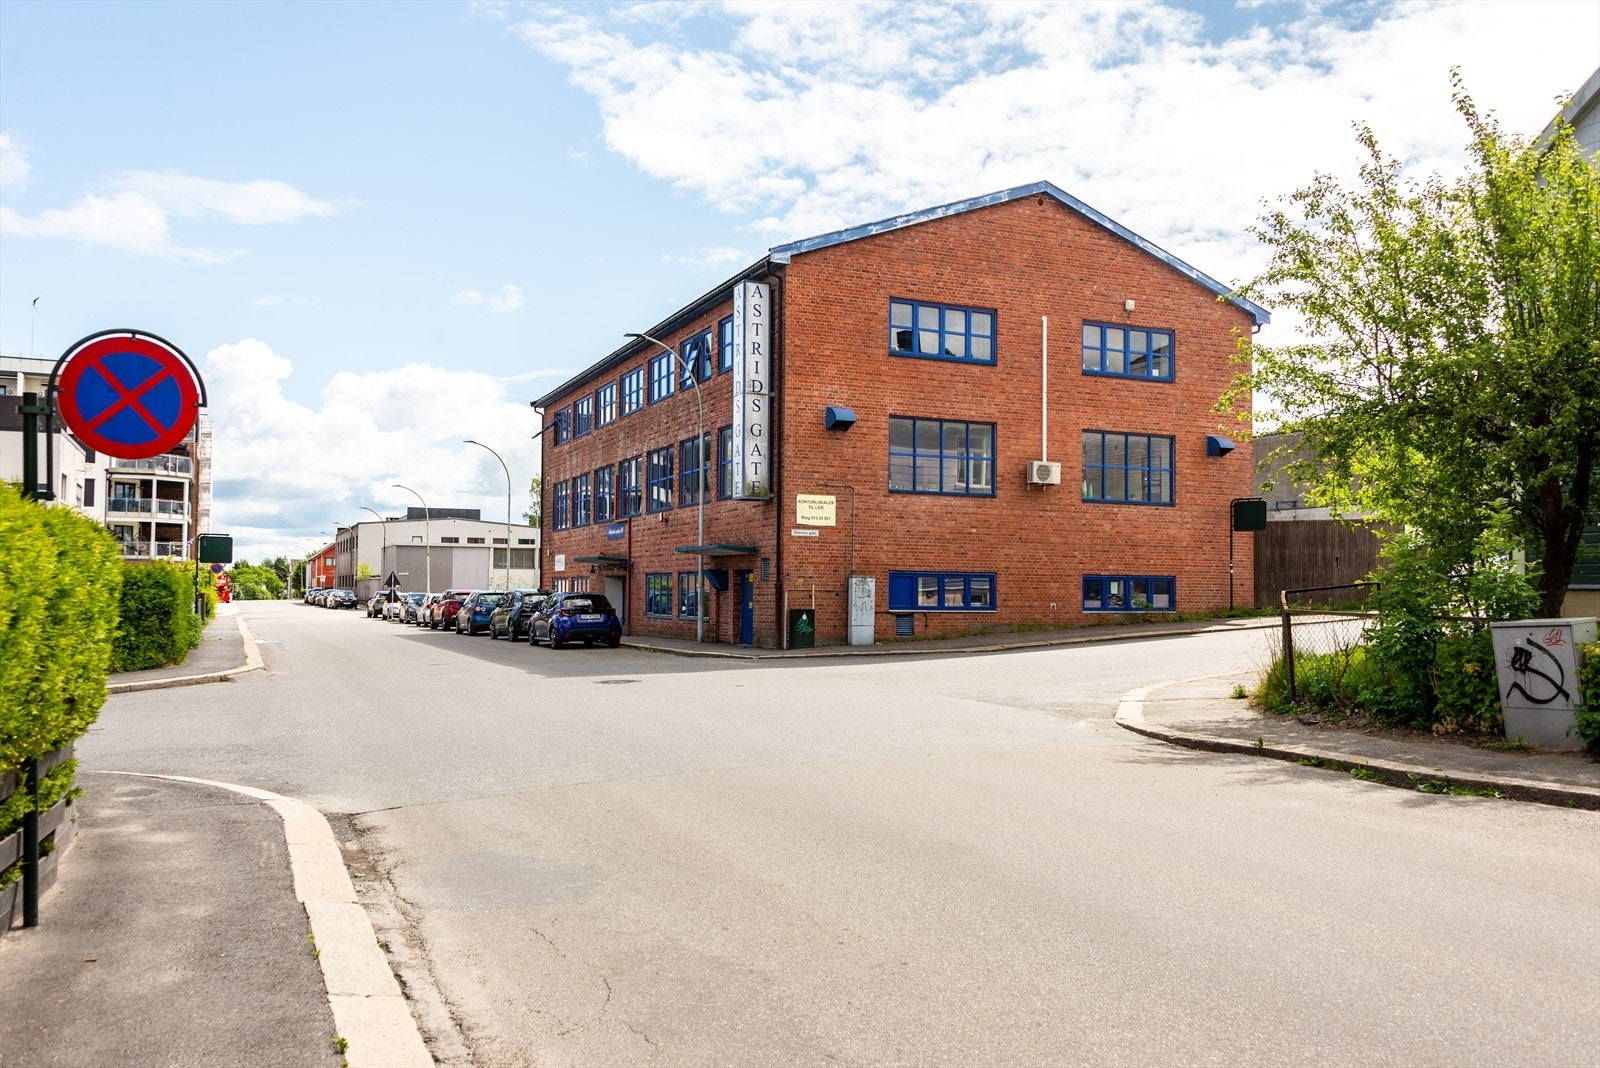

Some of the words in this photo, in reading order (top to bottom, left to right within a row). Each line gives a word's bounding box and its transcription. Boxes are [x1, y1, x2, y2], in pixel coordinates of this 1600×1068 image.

[734, 287, 743, 414] ASTRIDS
[750, 285, 764, 414] ASTRIDS
[734, 423, 742, 496] GATE
[750, 423, 763, 496] GATE
